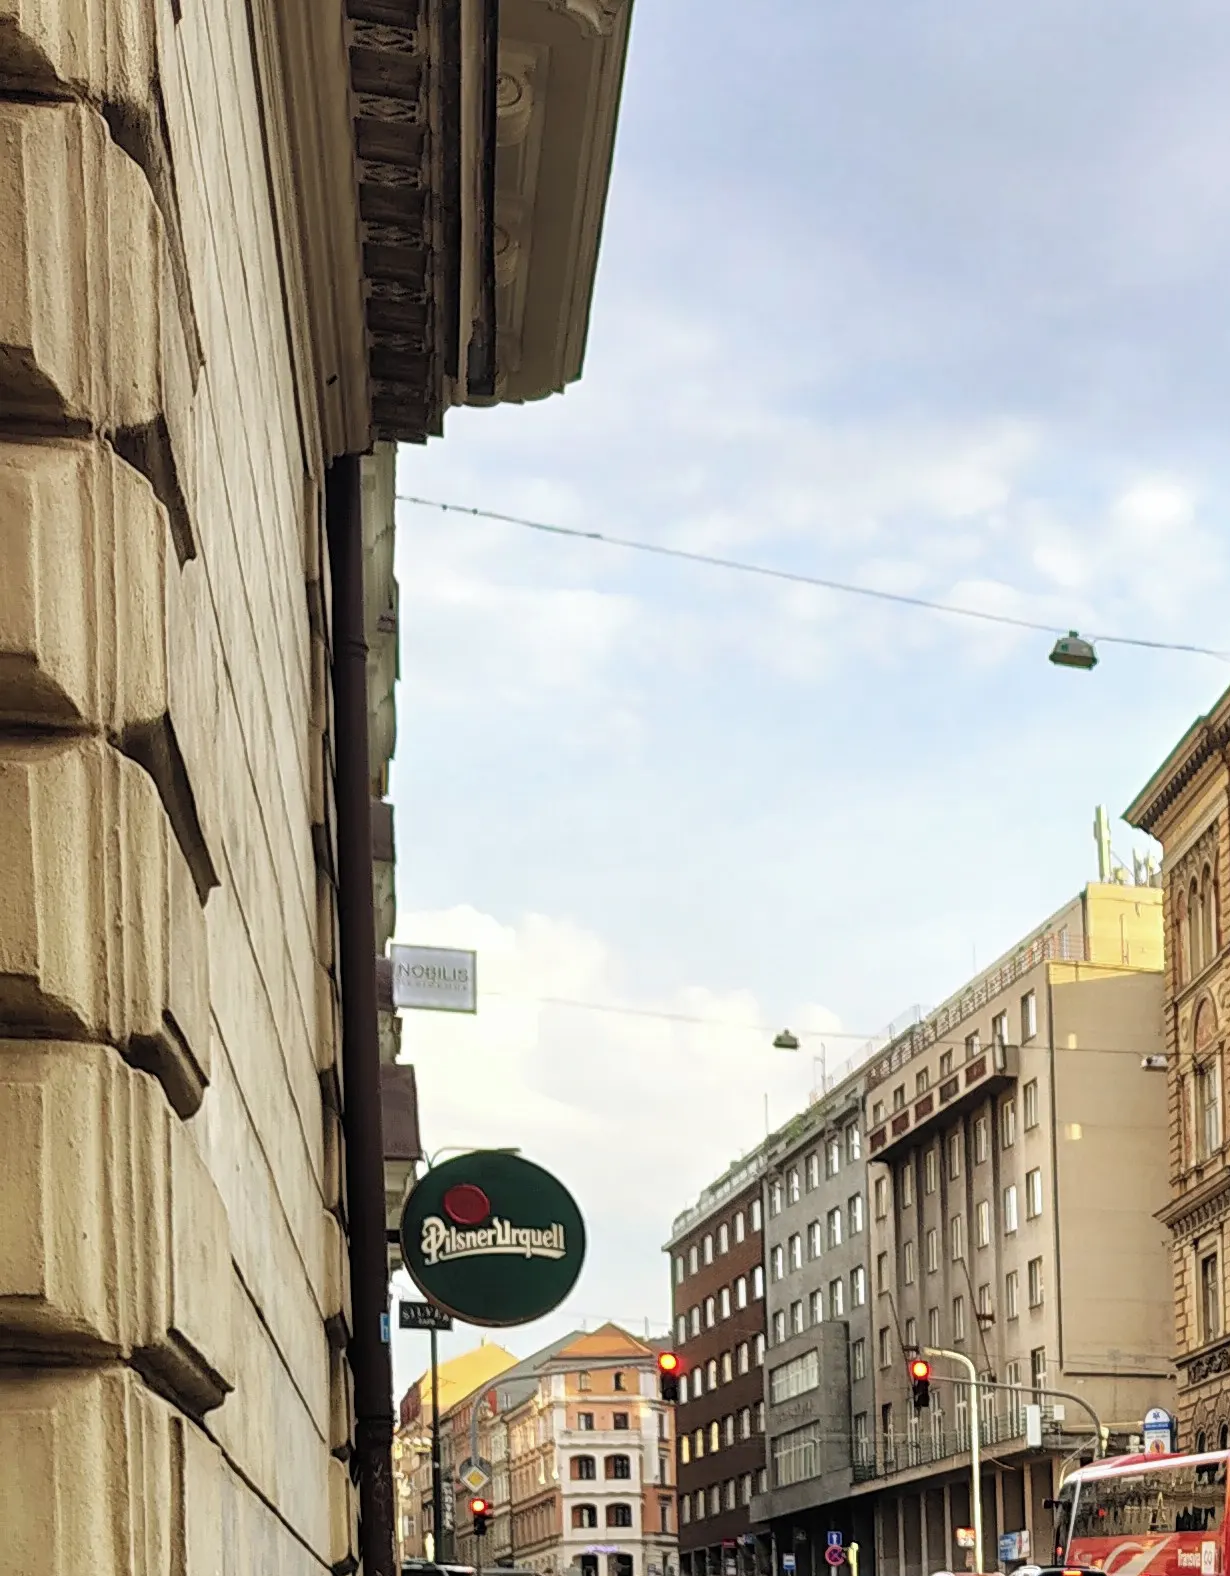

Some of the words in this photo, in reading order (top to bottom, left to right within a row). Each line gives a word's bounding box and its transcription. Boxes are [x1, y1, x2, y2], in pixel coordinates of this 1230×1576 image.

[398, 962, 469, 983] NOBILIS
[421, 1216, 497, 1266] Pilsner
[492, 1216, 567, 1259] Urquell
